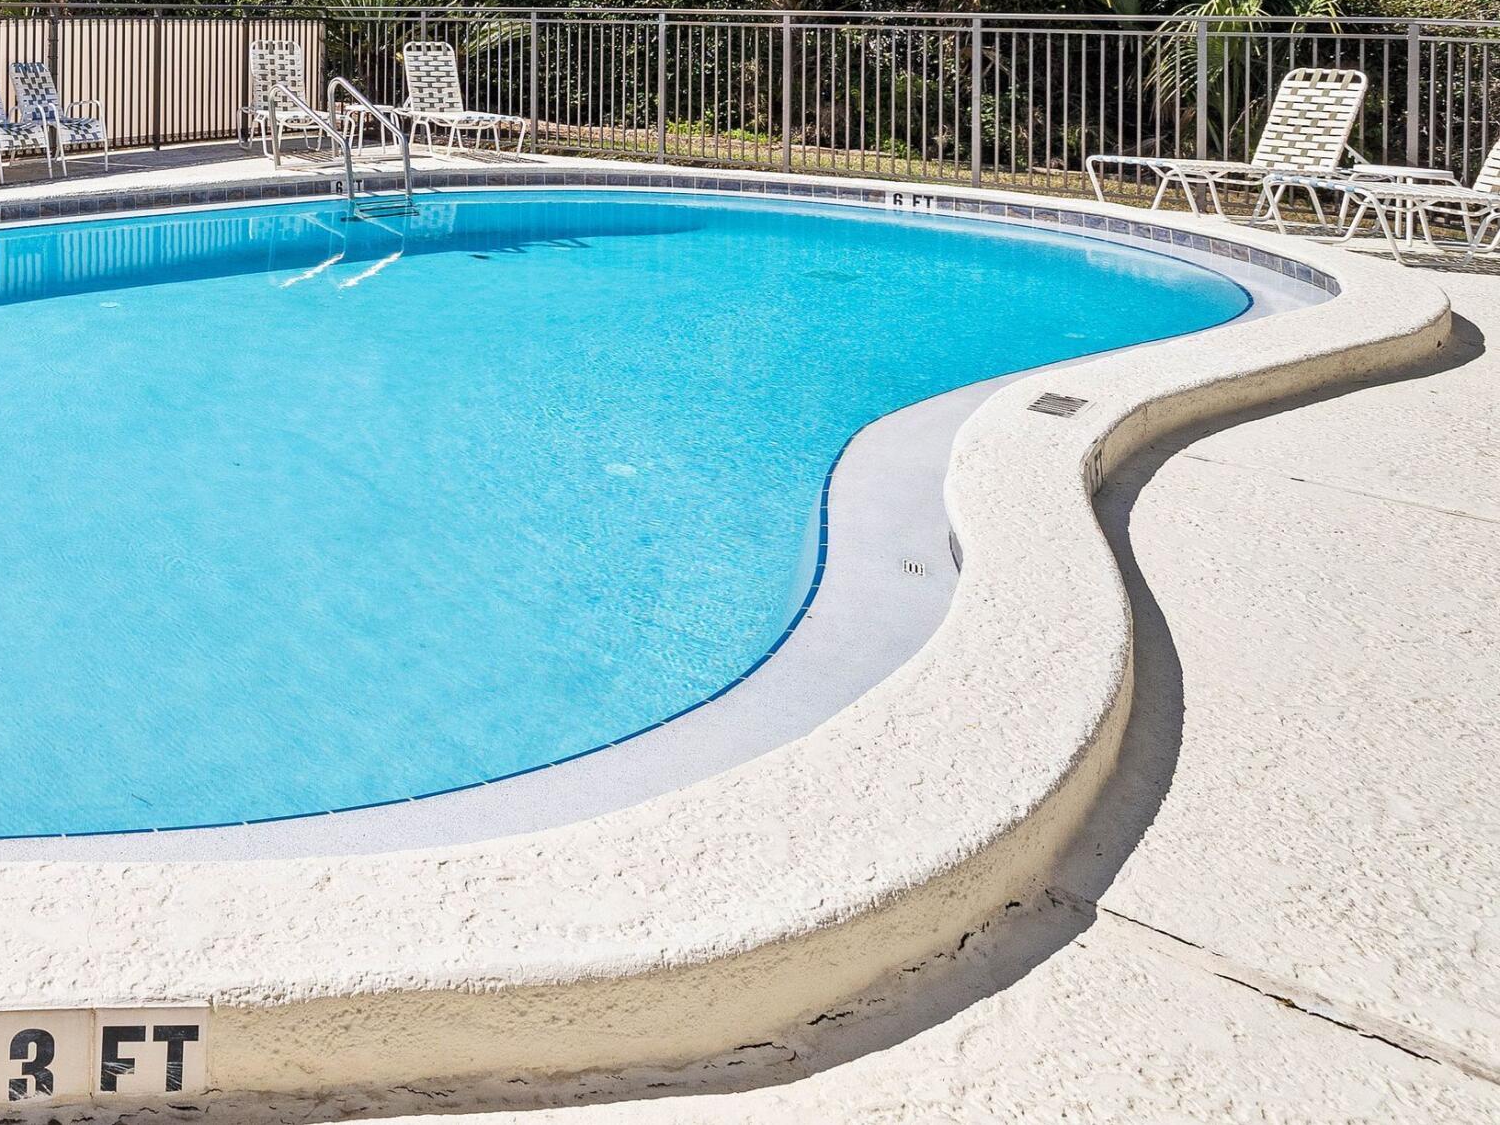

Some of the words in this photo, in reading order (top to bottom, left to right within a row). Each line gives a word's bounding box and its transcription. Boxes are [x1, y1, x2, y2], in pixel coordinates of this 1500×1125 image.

[912, 194, 934, 208] FT
[8, 1028, 55, 1101] 3
[100, 1025, 199, 1092] FT
